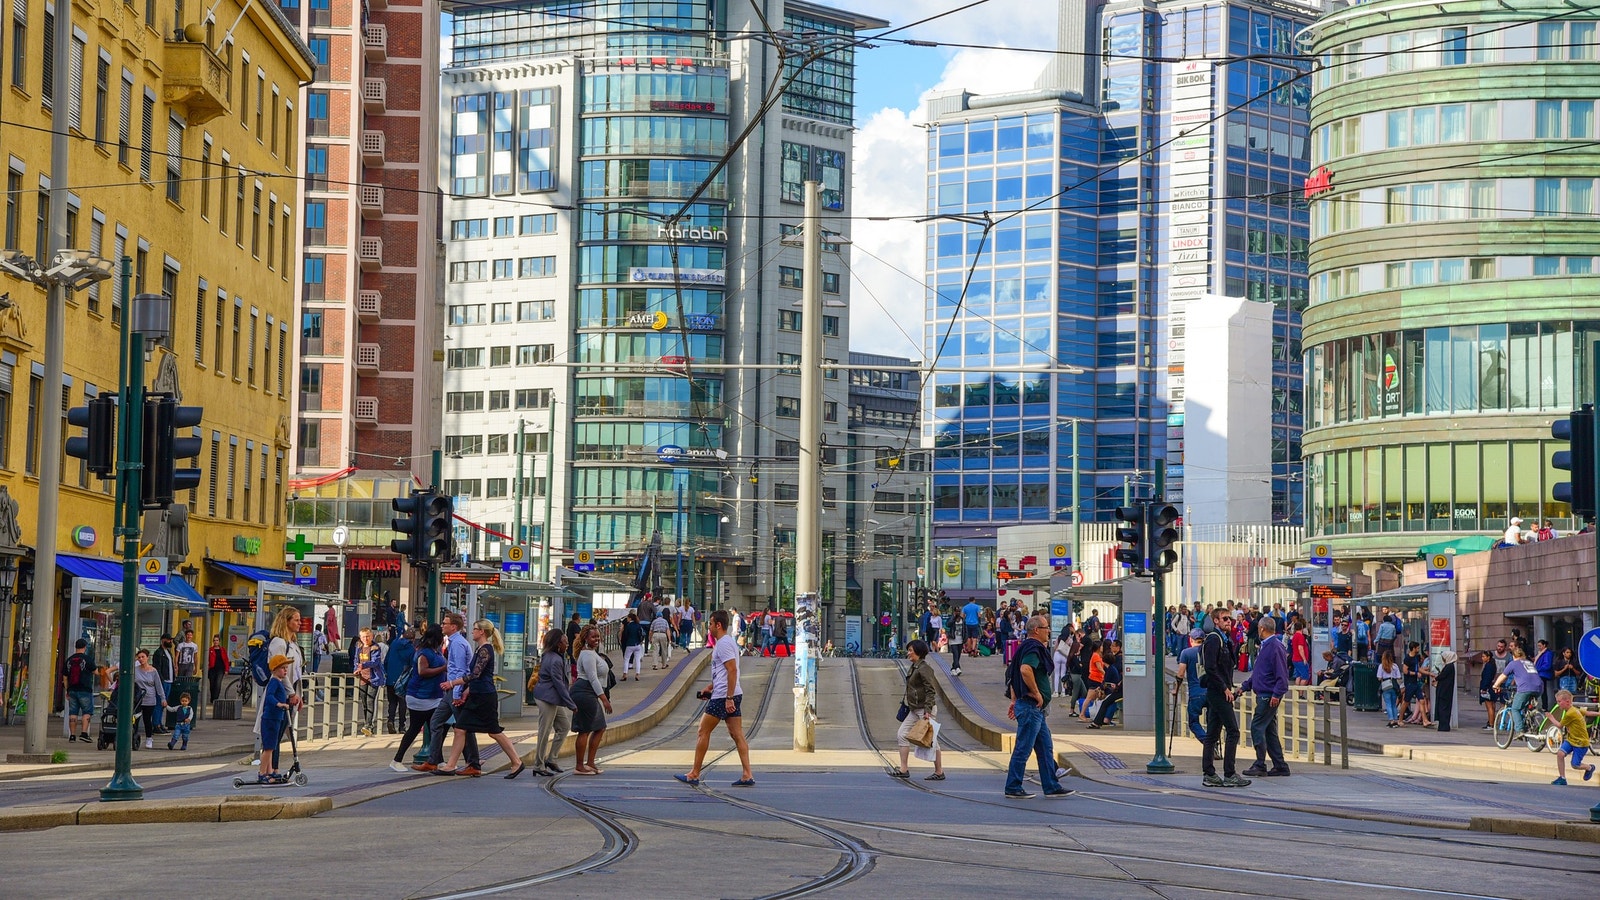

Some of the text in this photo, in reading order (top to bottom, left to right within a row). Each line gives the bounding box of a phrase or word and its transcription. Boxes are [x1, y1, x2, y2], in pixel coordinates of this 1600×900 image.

[1176, 74, 1205, 85] BIK BOK
[629, 313, 654, 325] AMFI
[1454, 508, 1477, 516] EGON
[336, 532, 344, 543] T
[512, 549, 520, 559] B
[1056, 546, 1063, 555] C
[1318, 547, 1325, 555] D
[581, 553, 588, 561] B
[1436, 557, 1444, 567] D
[149, 560, 157, 571] A
[302, 567, 310, 575] A
